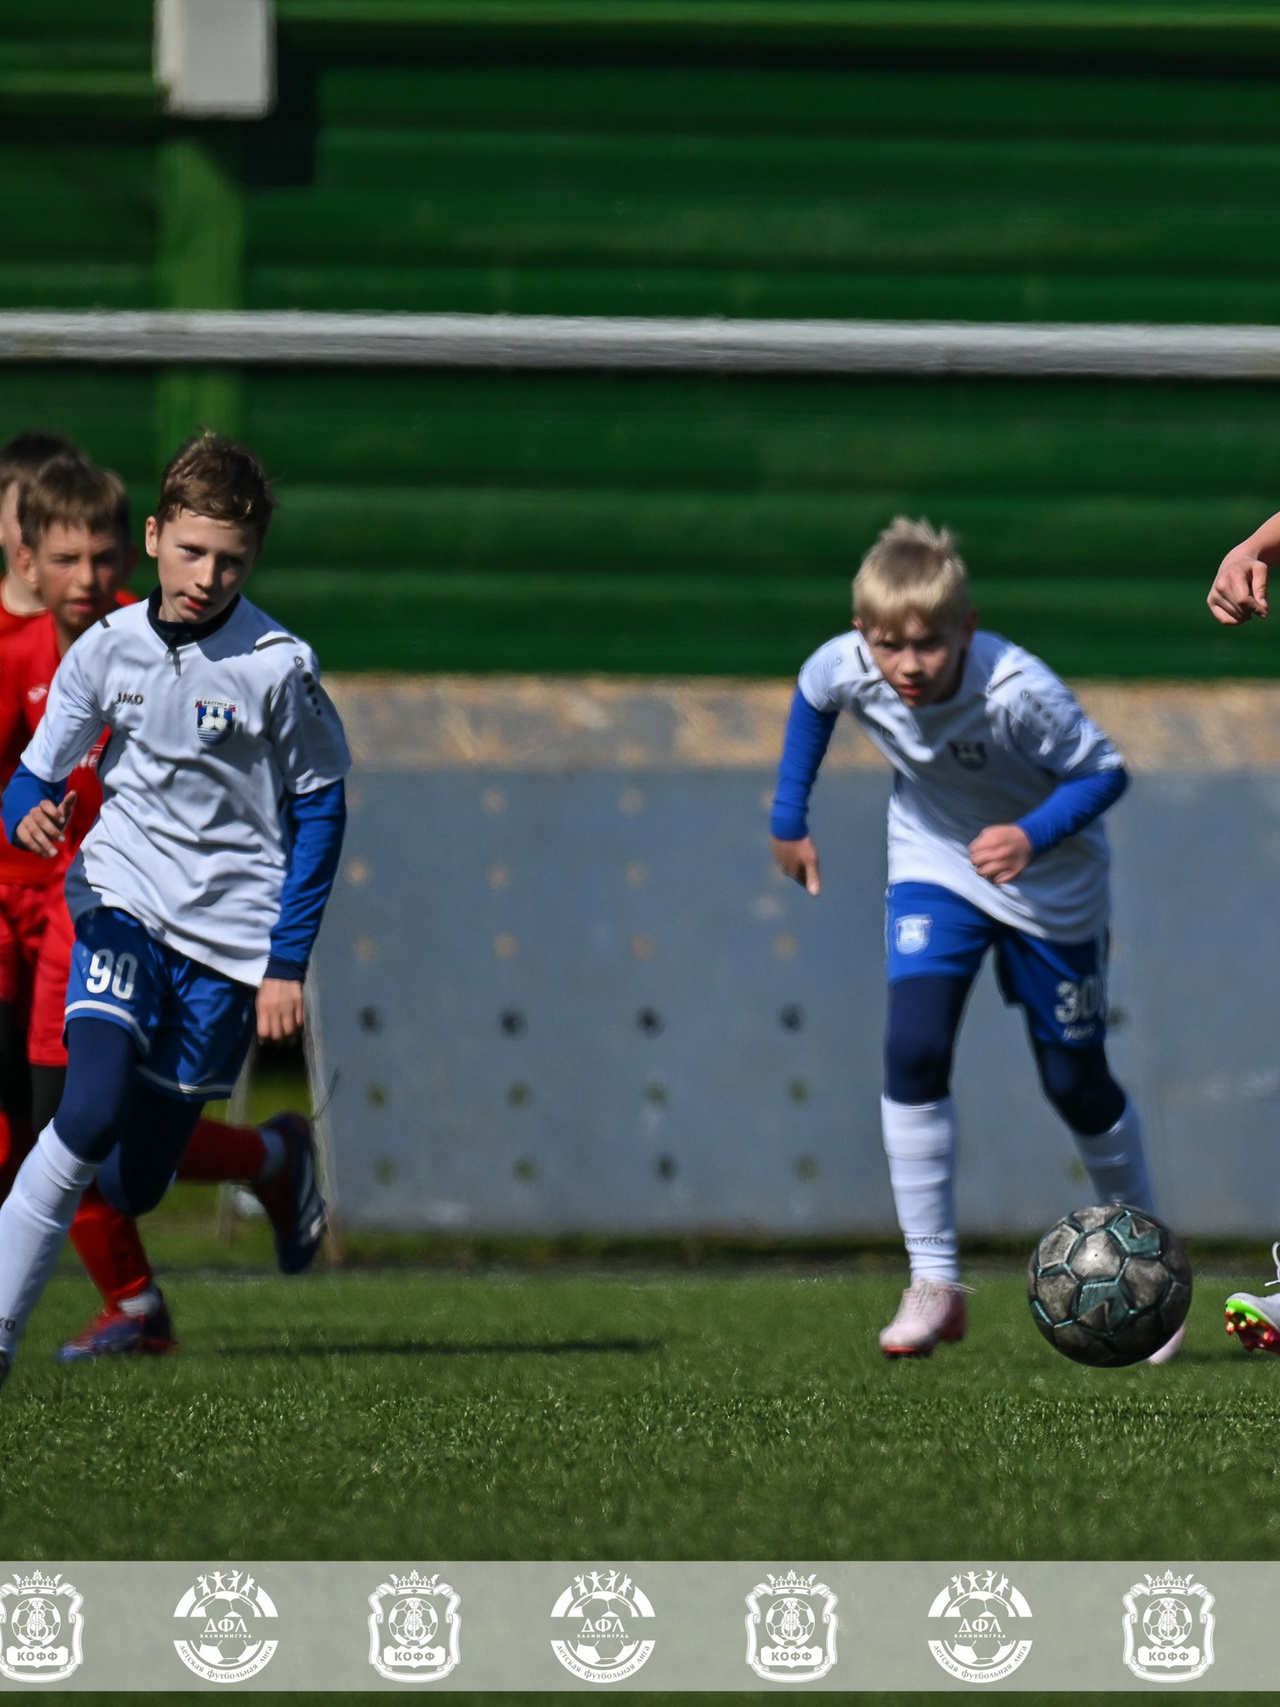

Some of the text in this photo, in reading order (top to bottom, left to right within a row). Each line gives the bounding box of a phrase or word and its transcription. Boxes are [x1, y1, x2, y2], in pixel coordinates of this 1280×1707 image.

[114, 691, 144, 706] JAKO
[86, 948, 138, 1000] 90
[1054, 976, 1099, 1024] 30
